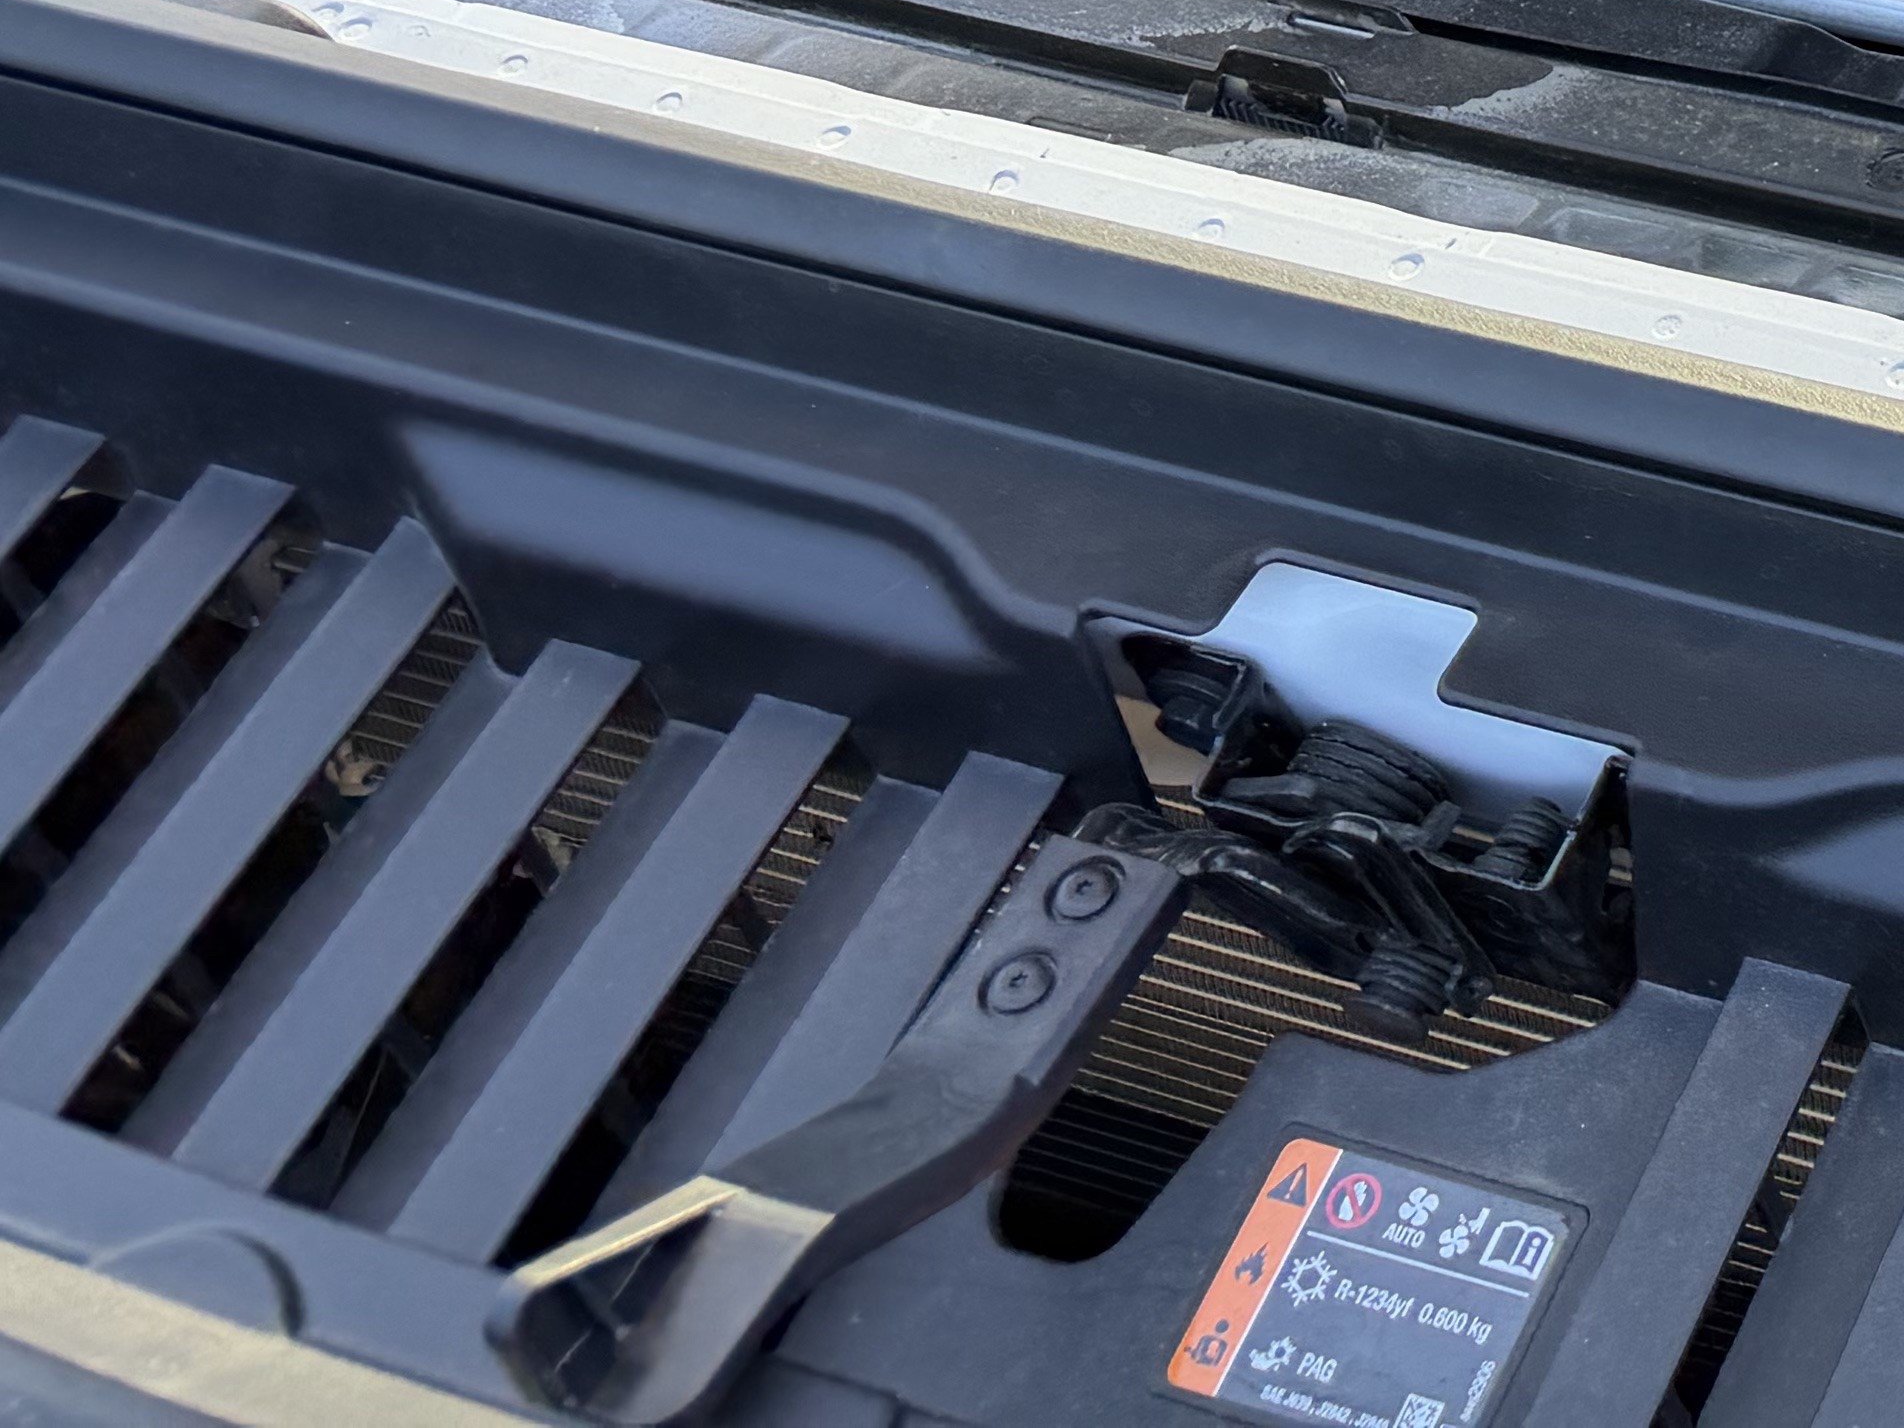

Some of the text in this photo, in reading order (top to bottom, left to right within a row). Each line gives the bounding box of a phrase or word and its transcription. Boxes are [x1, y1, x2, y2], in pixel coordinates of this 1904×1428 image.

[1382, 1223, 1426, 1248] AUTO
[1334, 1278, 1493, 1345] R-1234yf 0.600 kg
[1296, 1352, 1338, 1383] PAG
